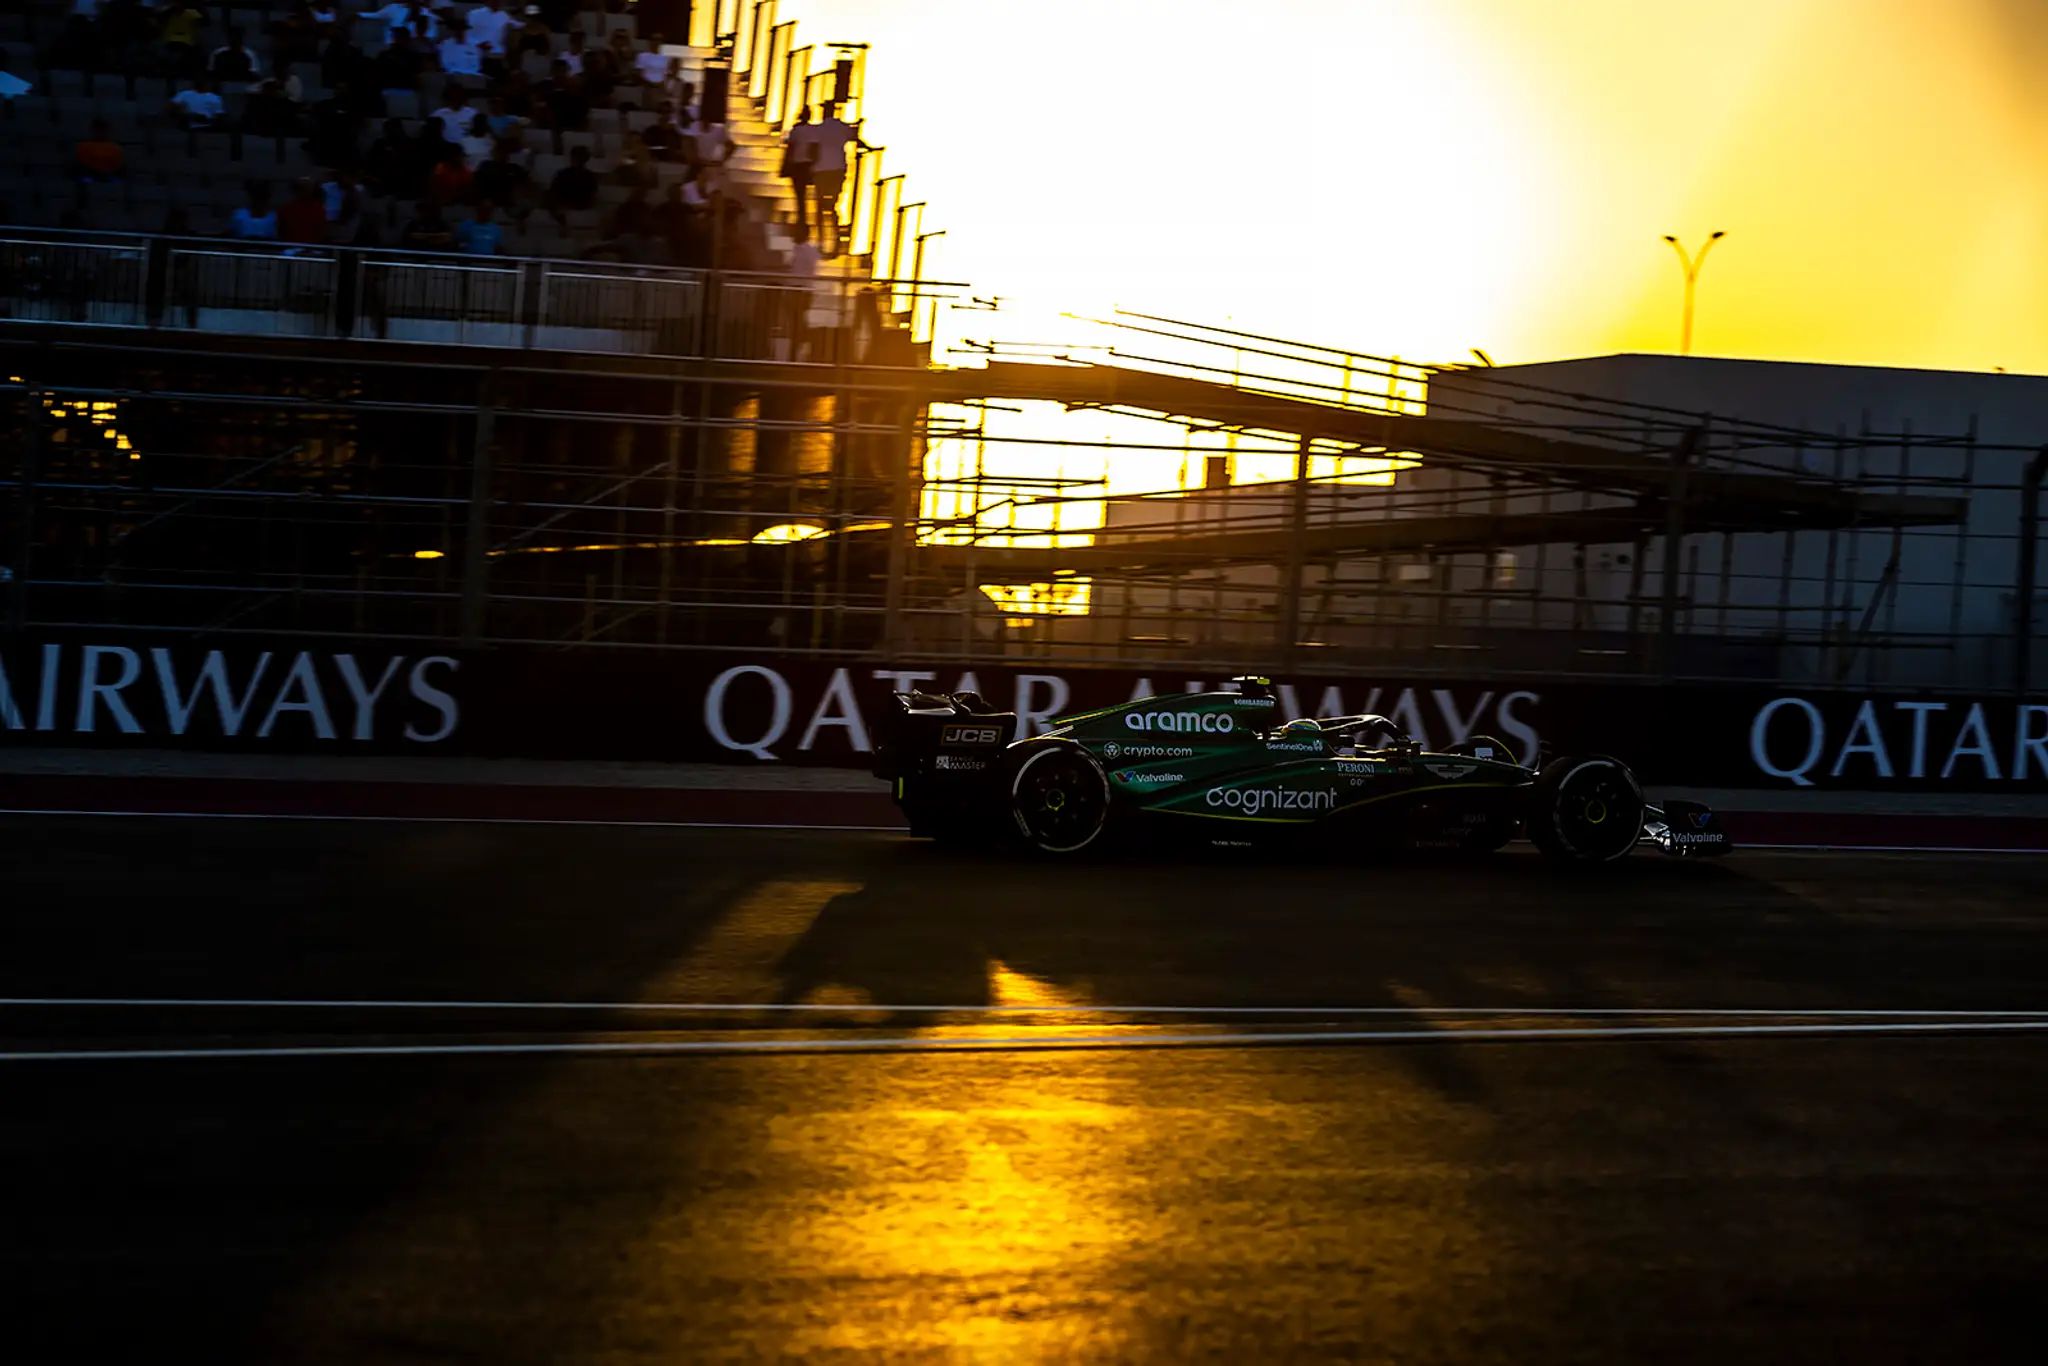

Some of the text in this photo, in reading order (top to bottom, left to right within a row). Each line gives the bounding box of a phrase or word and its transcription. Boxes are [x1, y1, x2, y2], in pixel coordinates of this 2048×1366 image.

[1124, 711, 1234, 733] aramco
[1128, 678, 1542, 769] WAYS
[945, 728, 998, 743] JCB
[1123, 746, 1193, 758] crypto.com
[1337, 762, 1375, 773] PERONI
[1136, 773, 1184, 782] Valvoline
[1206, 785, 1338, 815] cognizant
[1672, 831, 1723, 844] Valvoline
